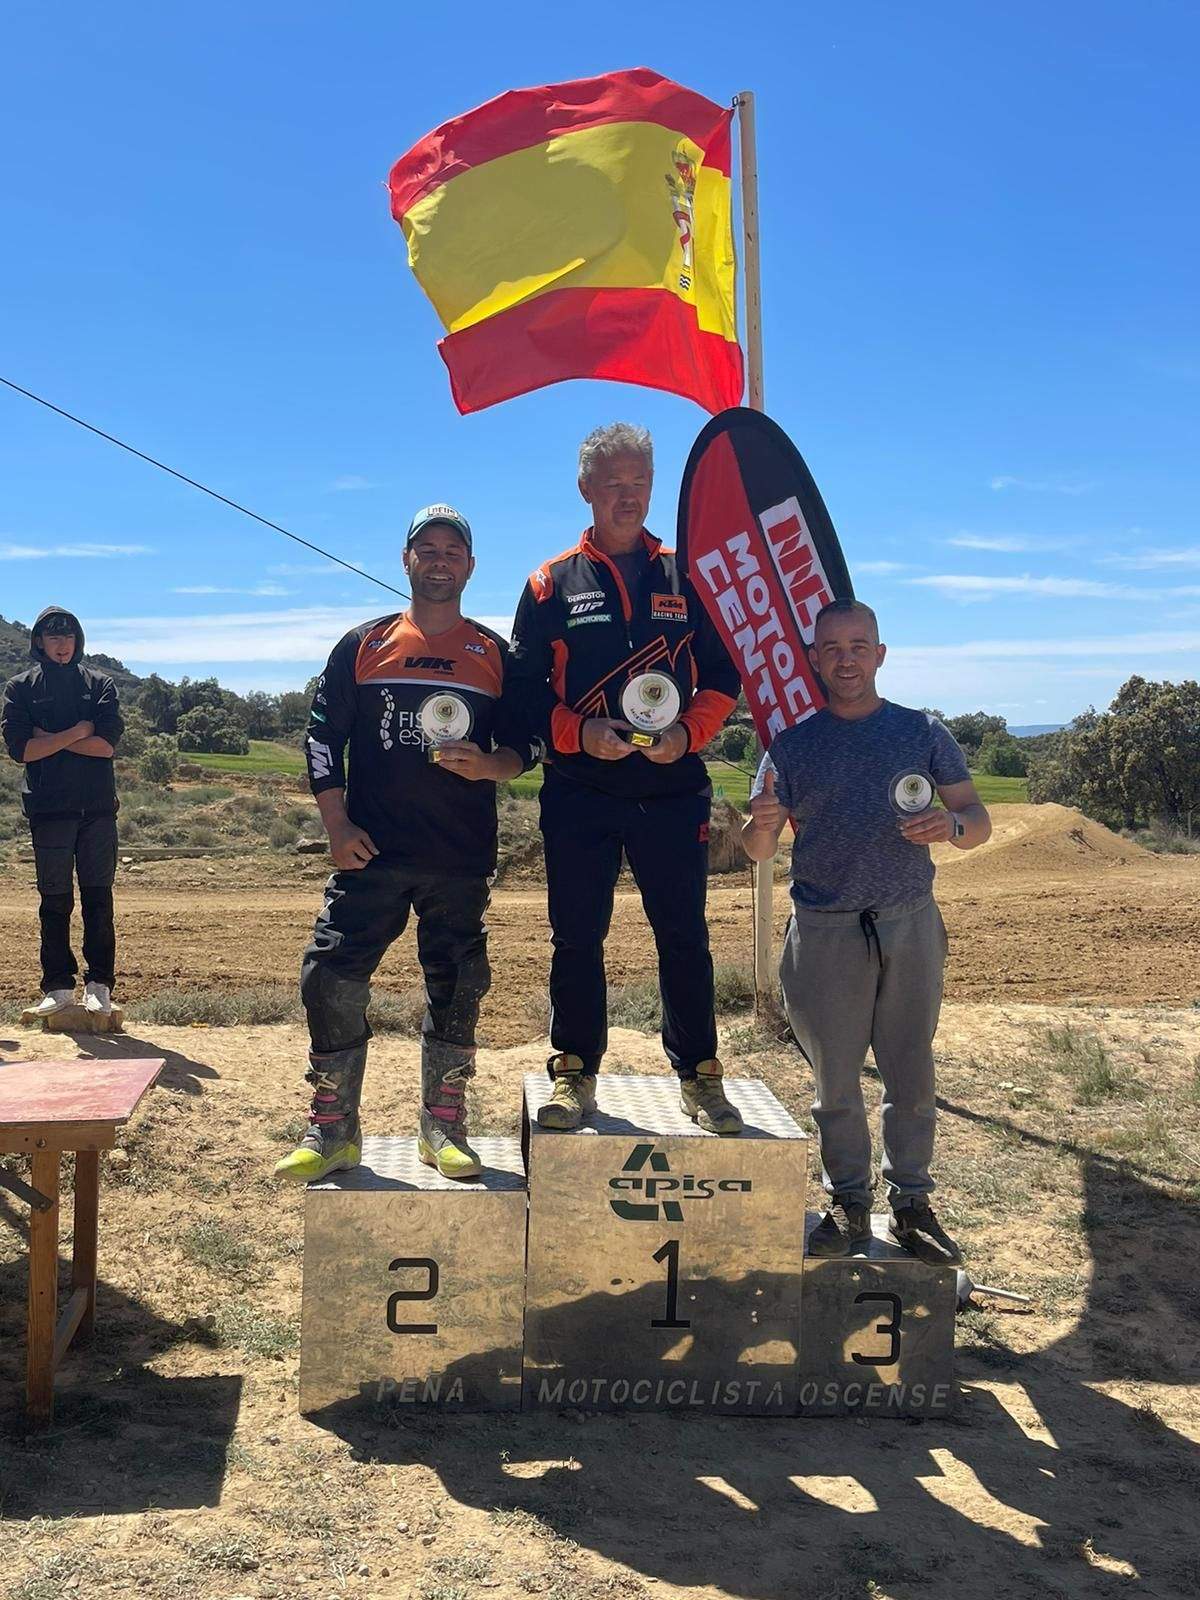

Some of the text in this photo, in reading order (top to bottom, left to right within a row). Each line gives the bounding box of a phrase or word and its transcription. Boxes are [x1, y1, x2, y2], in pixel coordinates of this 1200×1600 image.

[570, 601, 605, 615] WP
[608, 1174, 752, 1199] apisa
[386, 1257, 439, 1334] 2
[651, 1240, 691, 1329] 1
[851, 1291, 902, 1366] 3
[376, 1371, 951, 1408] PEÑA MOTOCICLISTA OSCENSE
